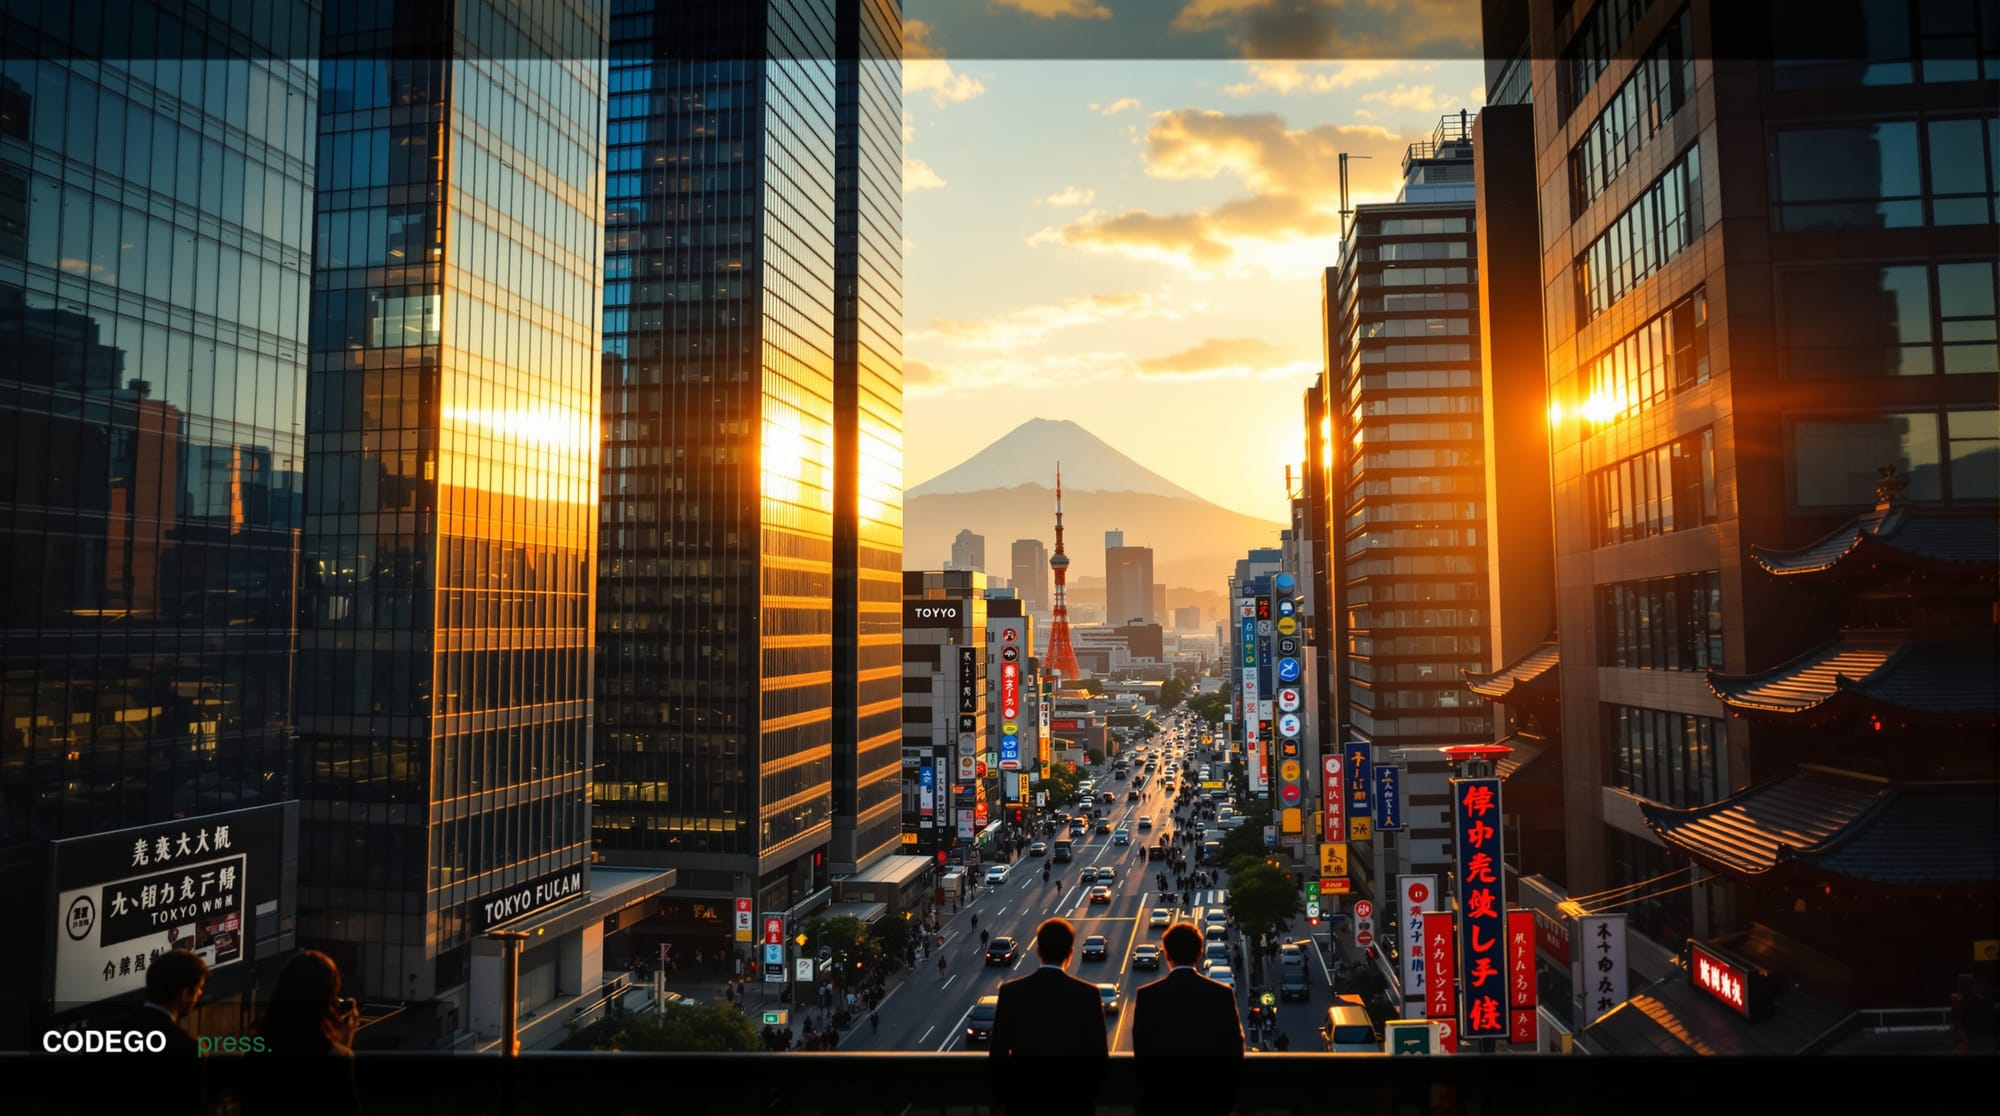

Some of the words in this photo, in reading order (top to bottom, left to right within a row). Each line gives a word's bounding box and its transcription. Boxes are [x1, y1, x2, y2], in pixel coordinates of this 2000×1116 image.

[915, 608, 957, 618] TOYYO
[151, 903, 198, 926] TOKYO
[484, 889, 532, 924] TOKYO
